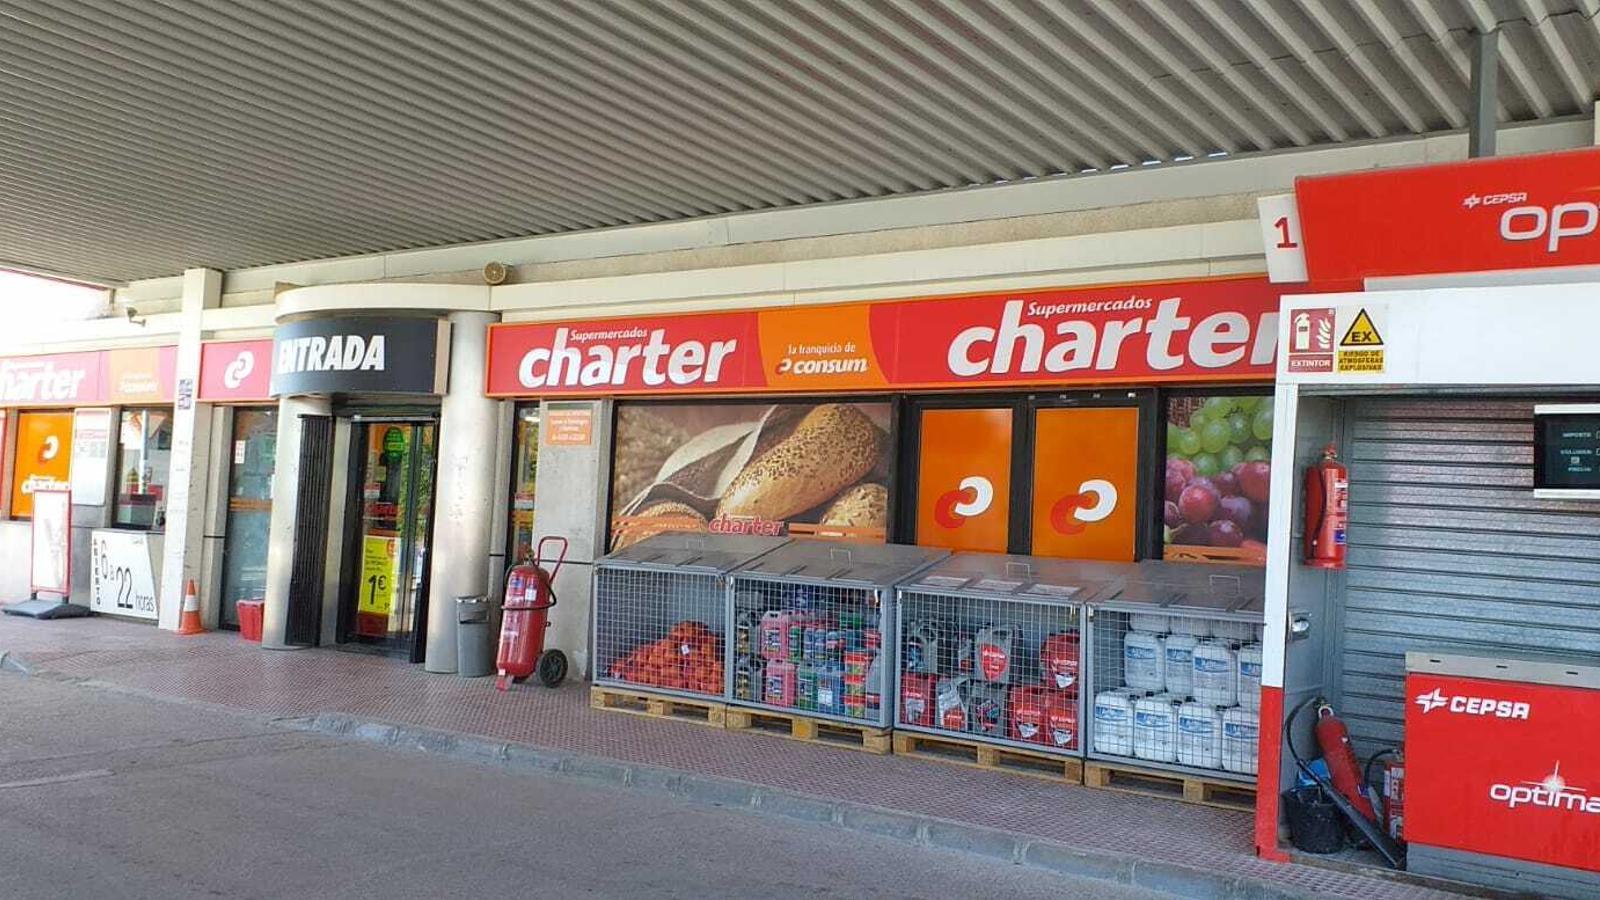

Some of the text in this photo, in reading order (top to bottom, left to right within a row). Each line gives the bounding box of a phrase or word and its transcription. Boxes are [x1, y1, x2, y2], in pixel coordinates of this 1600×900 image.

[1482, 192, 1527, 206] CEPSA
[1274, 217, 1298, 249] 1
[1500, 201, 1600, 253] op
[1027, 296, 1153, 318] Supermercados
[569, 327, 649, 344] Supermercados
[844, 341, 857, 352] de
[1351, 331, 1373, 342] EX
[278, 335, 386, 373] ENTRADA
[518, 327, 737, 389] charter
[1291, 360, 1331, 368] EXTINTOR
[793, 357, 868, 375] consum
[709, 513, 783, 535] charter
[116, 566, 134, 609] 22
[1450, 696, 1530, 720] CEPSA
